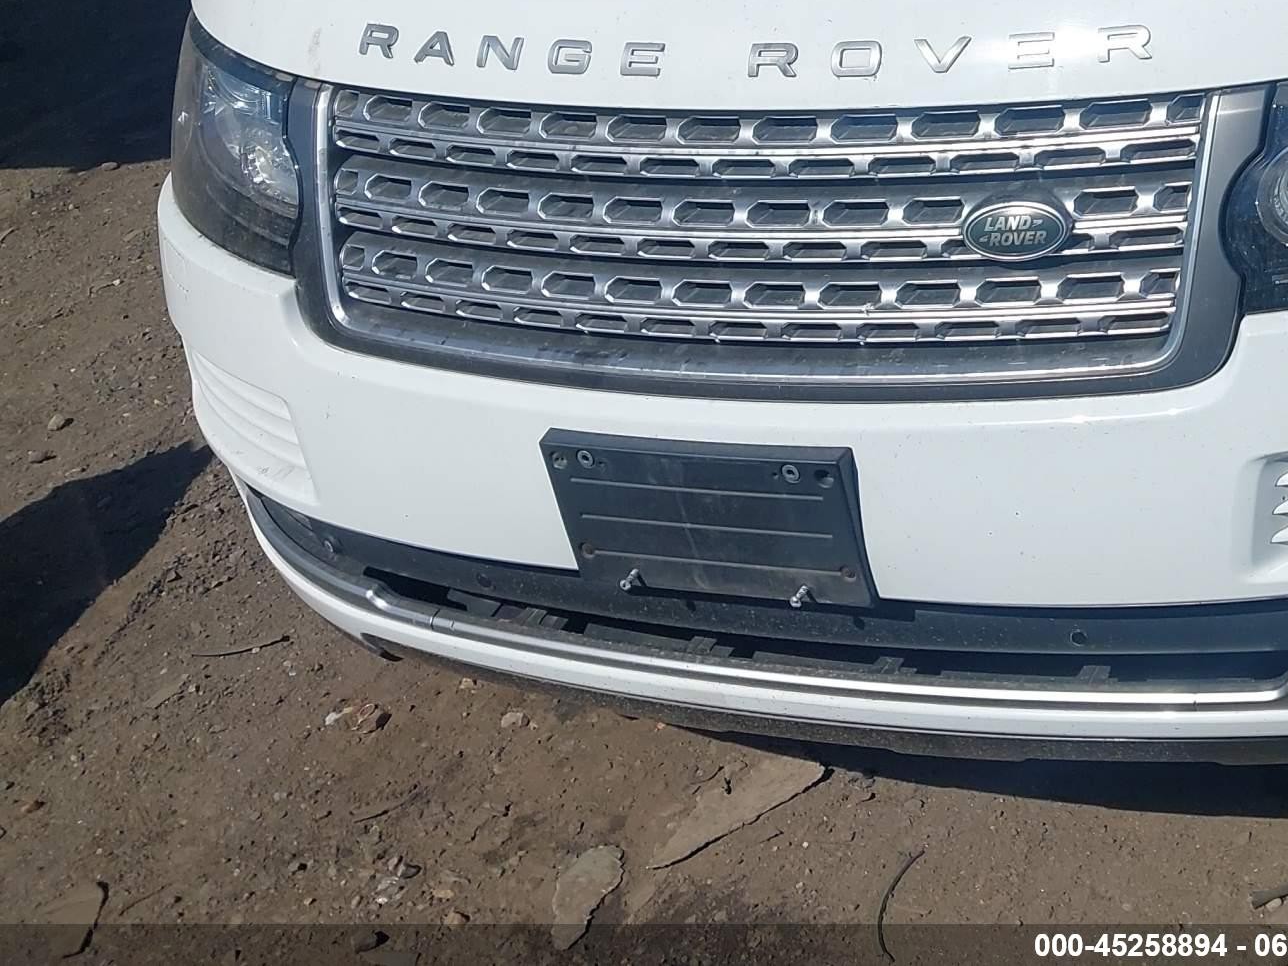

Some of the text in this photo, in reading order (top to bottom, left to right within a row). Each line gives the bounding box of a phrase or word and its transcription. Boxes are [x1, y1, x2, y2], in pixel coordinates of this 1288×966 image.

[358, 22, 1153, 78] RANGE ROVER
[984, 215, 1031, 232] LAND
[989, 231, 1047, 246] ROVER
